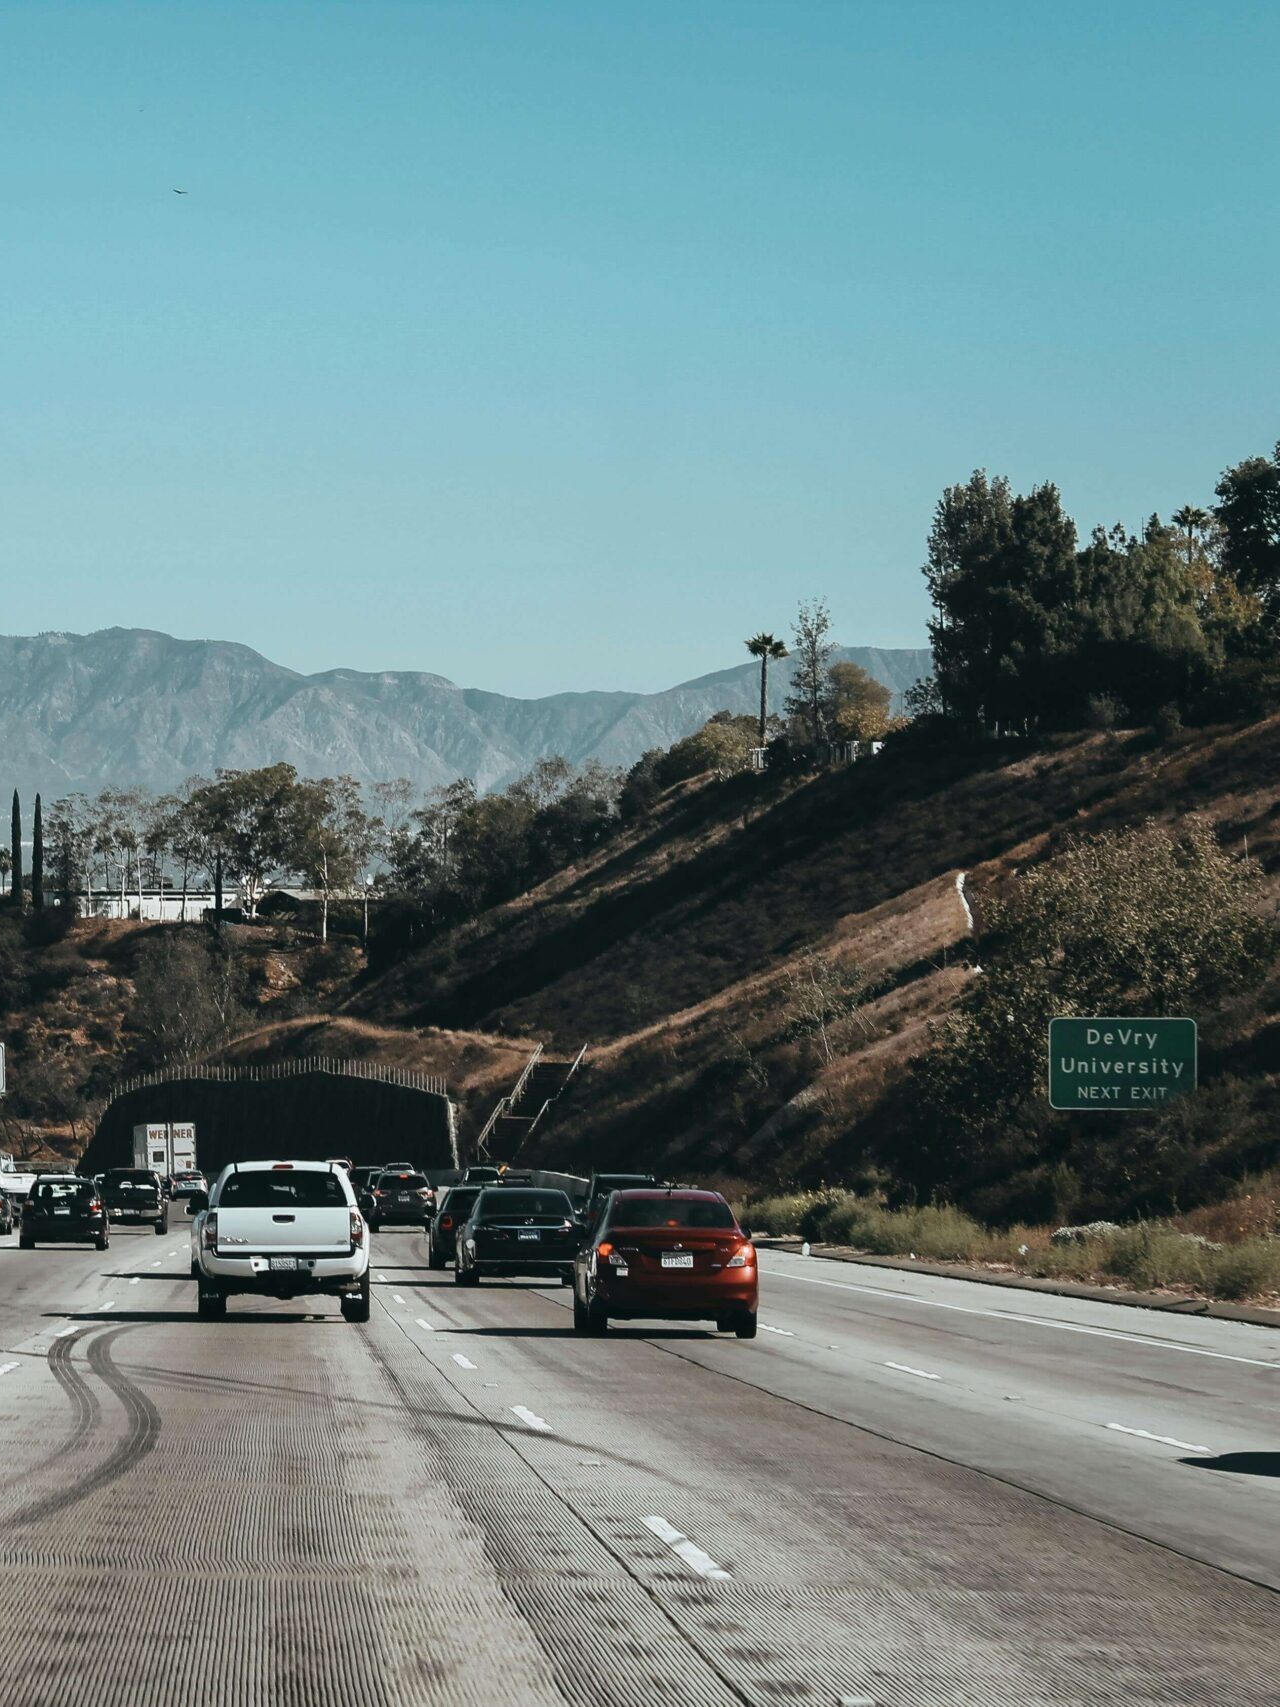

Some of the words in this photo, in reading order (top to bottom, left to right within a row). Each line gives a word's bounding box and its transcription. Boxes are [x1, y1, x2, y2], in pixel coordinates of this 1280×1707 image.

[1087, 1029, 1158, 1050] DeVry
[1061, 1057, 1184, 1078] University
[1077, 1086, 1121, 1099] NEXT
[1130, 1087, 1167, 1099] EXIT
